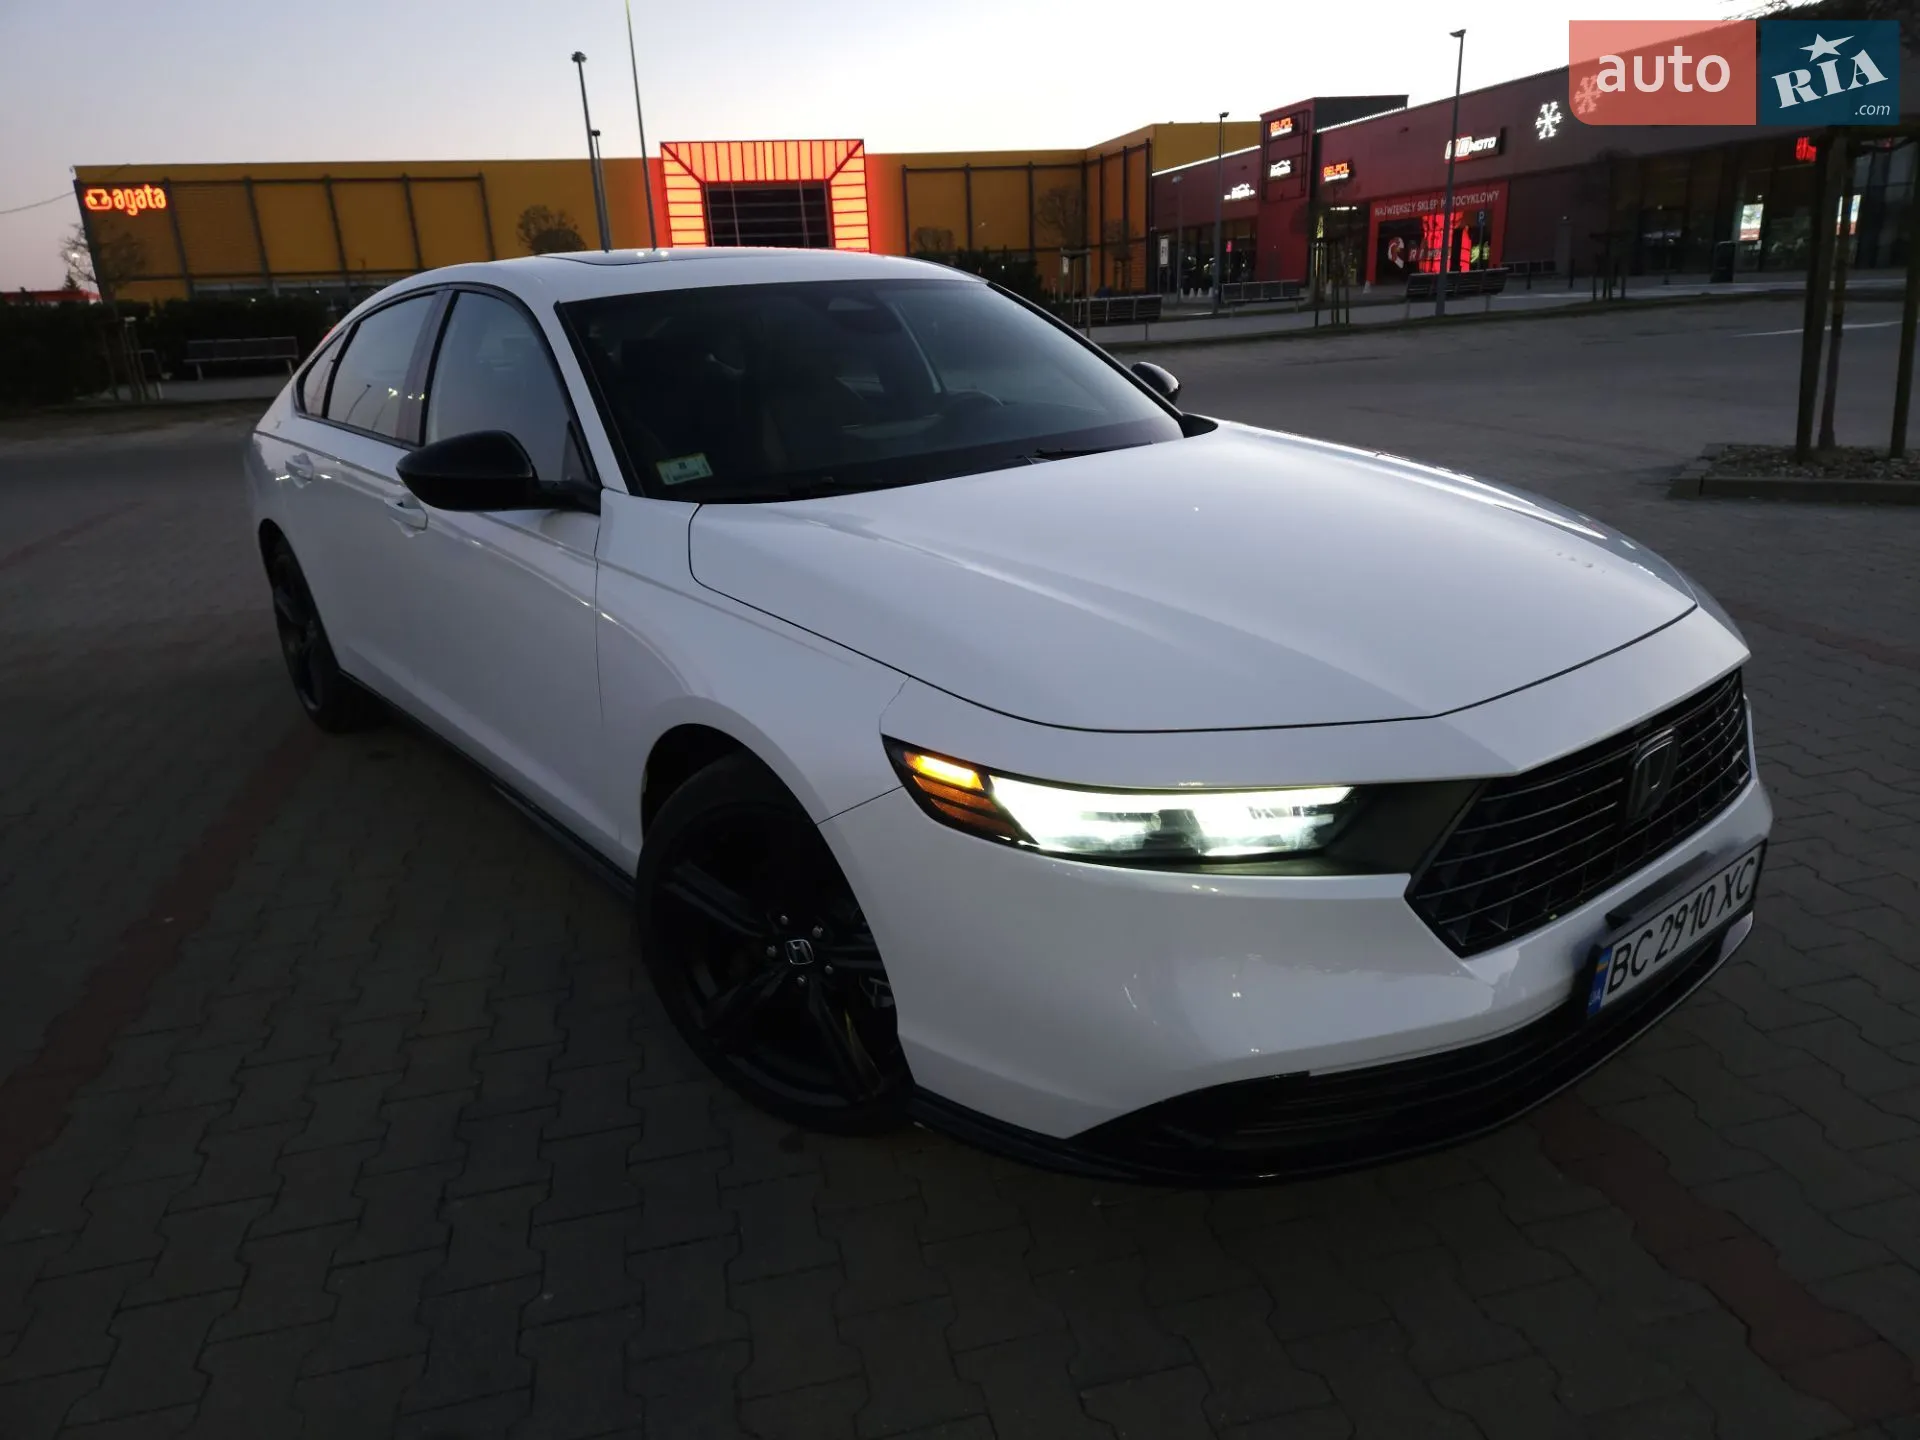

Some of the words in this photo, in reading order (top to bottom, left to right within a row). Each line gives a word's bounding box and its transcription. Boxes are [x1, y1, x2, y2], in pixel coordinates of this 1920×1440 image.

[112, 184, 167, 216] agata
[1418, 199, 1437, 210] SKLEP
[1441, 190, 1500, 208] MTOCYKLOWY
[1607, 929, 1653, 995] BC
[1654, 884, 1716, 963] 2910
[1717, 856, 1755, 917] XC
